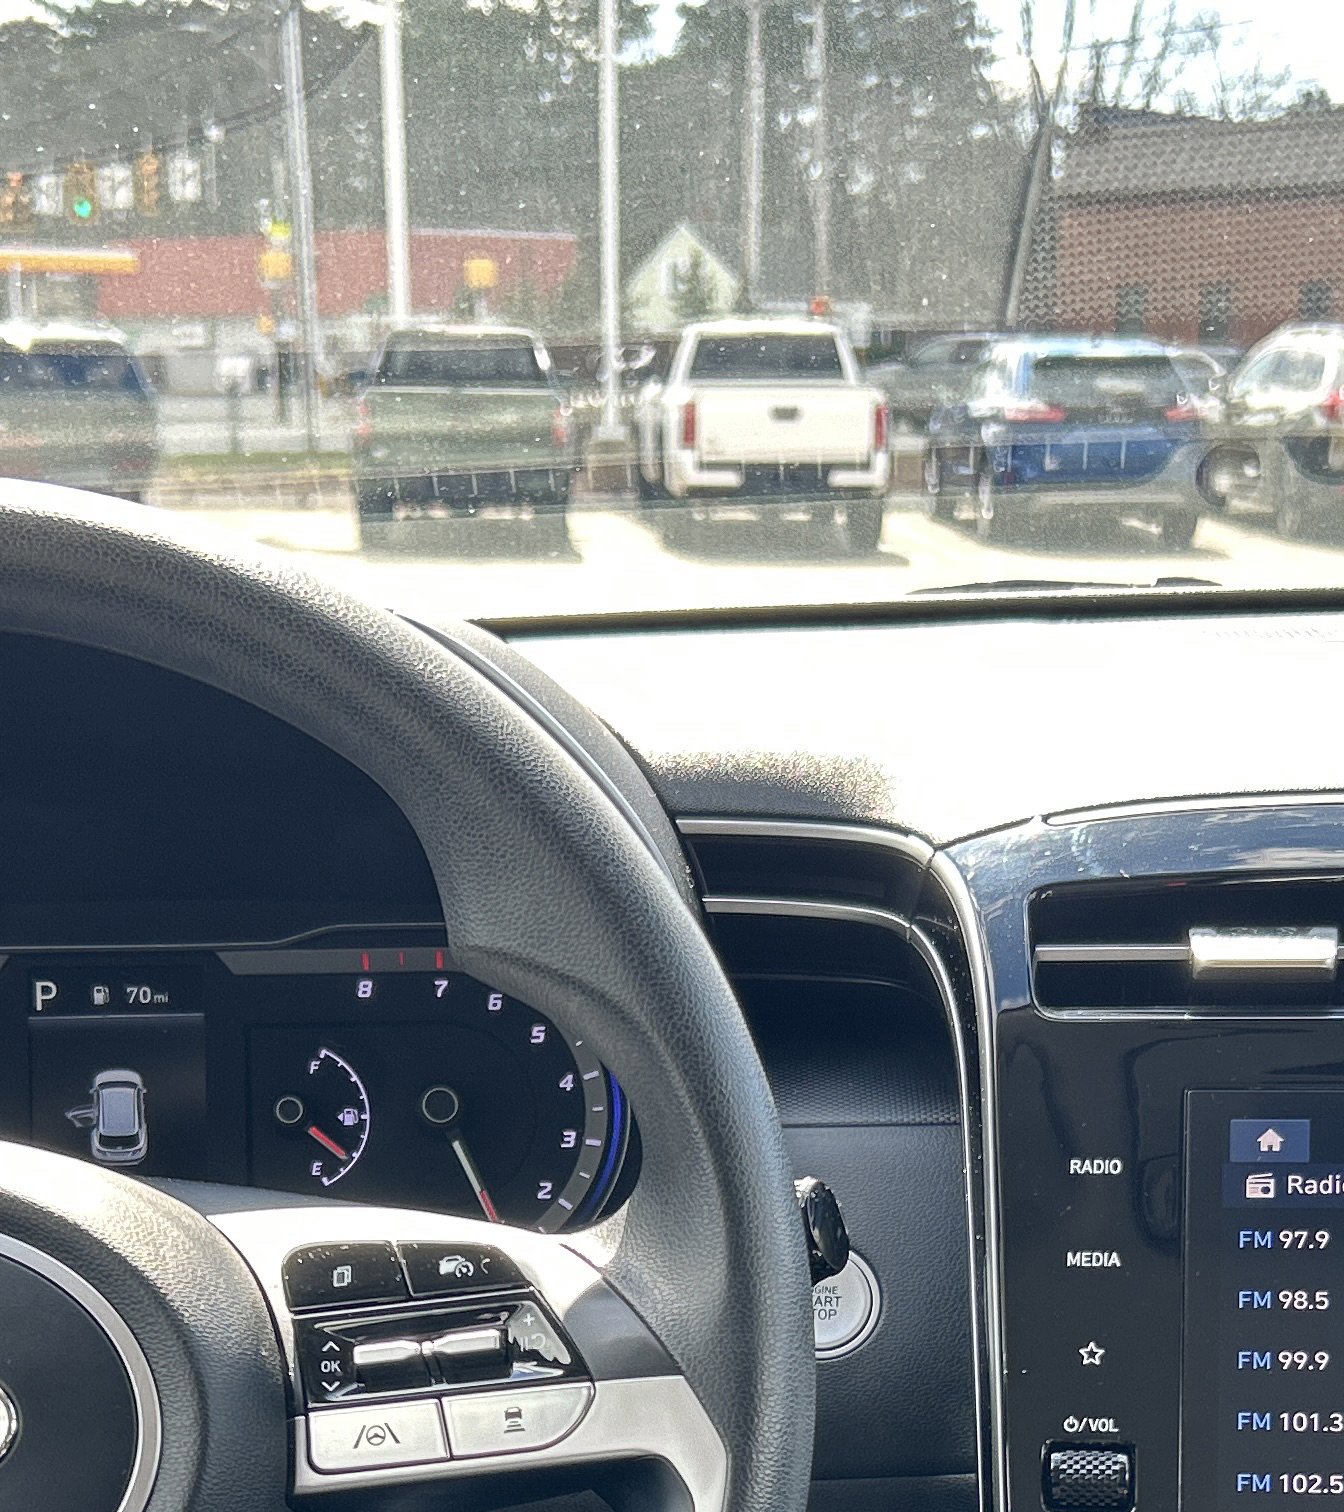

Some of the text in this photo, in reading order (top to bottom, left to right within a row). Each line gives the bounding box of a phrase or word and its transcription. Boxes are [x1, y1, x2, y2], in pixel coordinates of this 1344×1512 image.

[35, 980, 57, 1011] P
[357, 980, 373, 998] 8
[434, 979, 449, 998] 7
[487, 993, 503, 1011] 6
[530, 1025, 546, 1044] 5
[309, 1060, 321, 1075] F
[559, 1074, 574, 1092] 4
[560, 1131, 577, 1149] 3
[311, 1161, 323, 1176] E
[1069, 1158, 1123, 1175] RADIO
[536, 1181, 553, 1200] 2
[1239, 1230, 1331, 1250] FM 97.9
[1066, 1251, 1122, 1268] MEDIA
[813, 1295, 843, 1308] ART
[1238, 1290, 1330, 1310] FM 98.5
[320, 1360, 341, 1373] OK
[1238, 1351, 1330, 1371] FM 99.9
[1237, 1412, 1344, 1433] FM 101.3
[1237, 1473, 1344, 1494] FM 102.5
